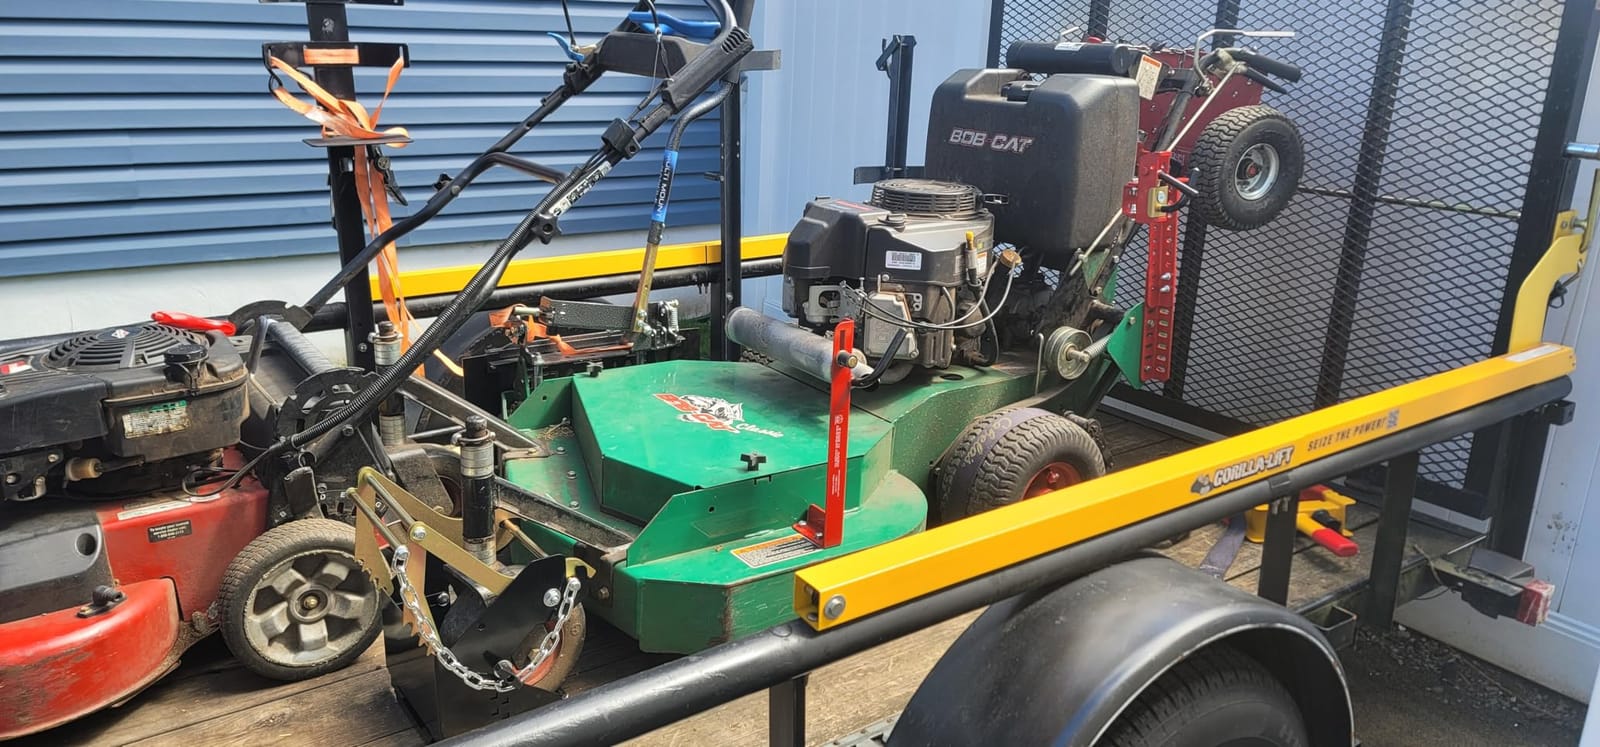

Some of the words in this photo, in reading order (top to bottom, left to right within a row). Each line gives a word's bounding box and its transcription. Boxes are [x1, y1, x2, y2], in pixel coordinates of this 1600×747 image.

[656, 183, 668, 218] MOUNT
[1307, 437, 1333, 452] SEIZE
[1336, 430, 1353, 445] THE
[1213, 446, 1294, 487] GORILLA-LIFT
